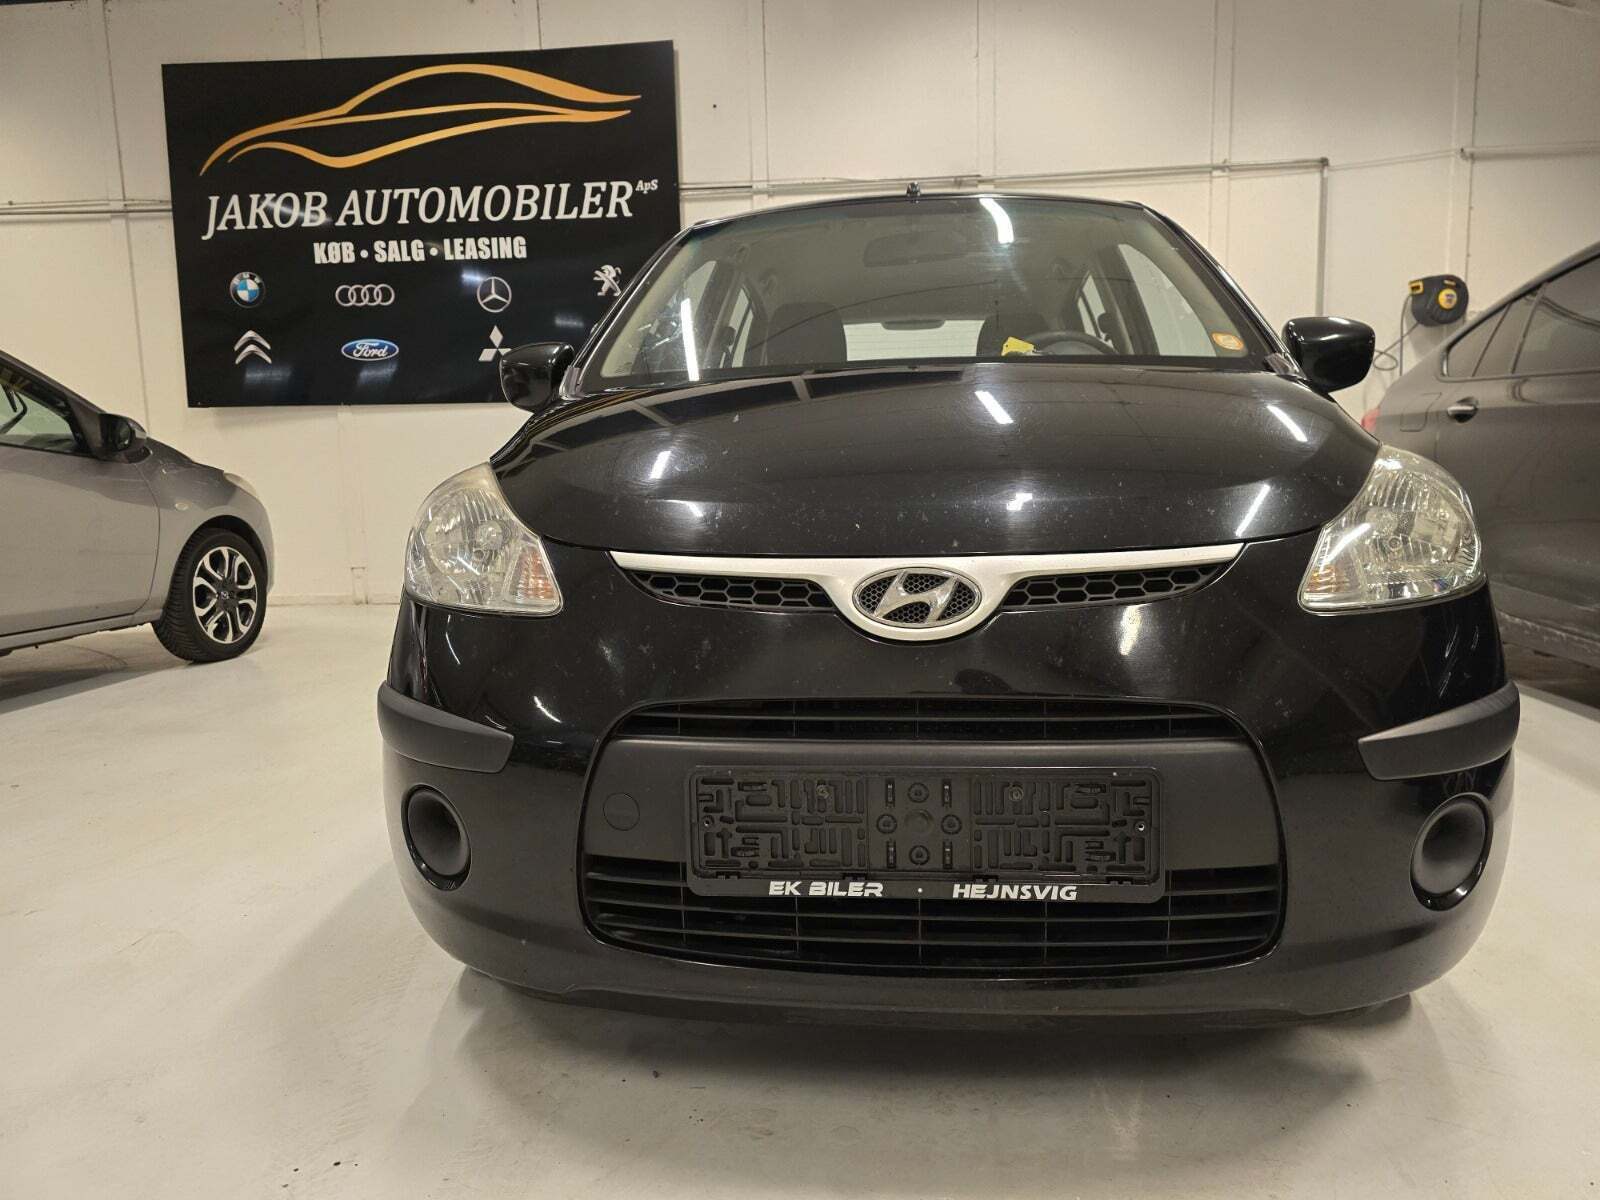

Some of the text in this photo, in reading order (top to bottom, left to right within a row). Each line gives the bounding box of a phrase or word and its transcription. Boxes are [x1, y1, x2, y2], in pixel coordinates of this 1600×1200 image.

[201, 179, 659, 241] JAKOB AUTOMOBILER ApS
[313, 236, 528, 264] KØB SALG LEASING
[352, 342, 389, 358] Ford
[768, 880, 1078, 900] EK BILER HEJNSVIG
